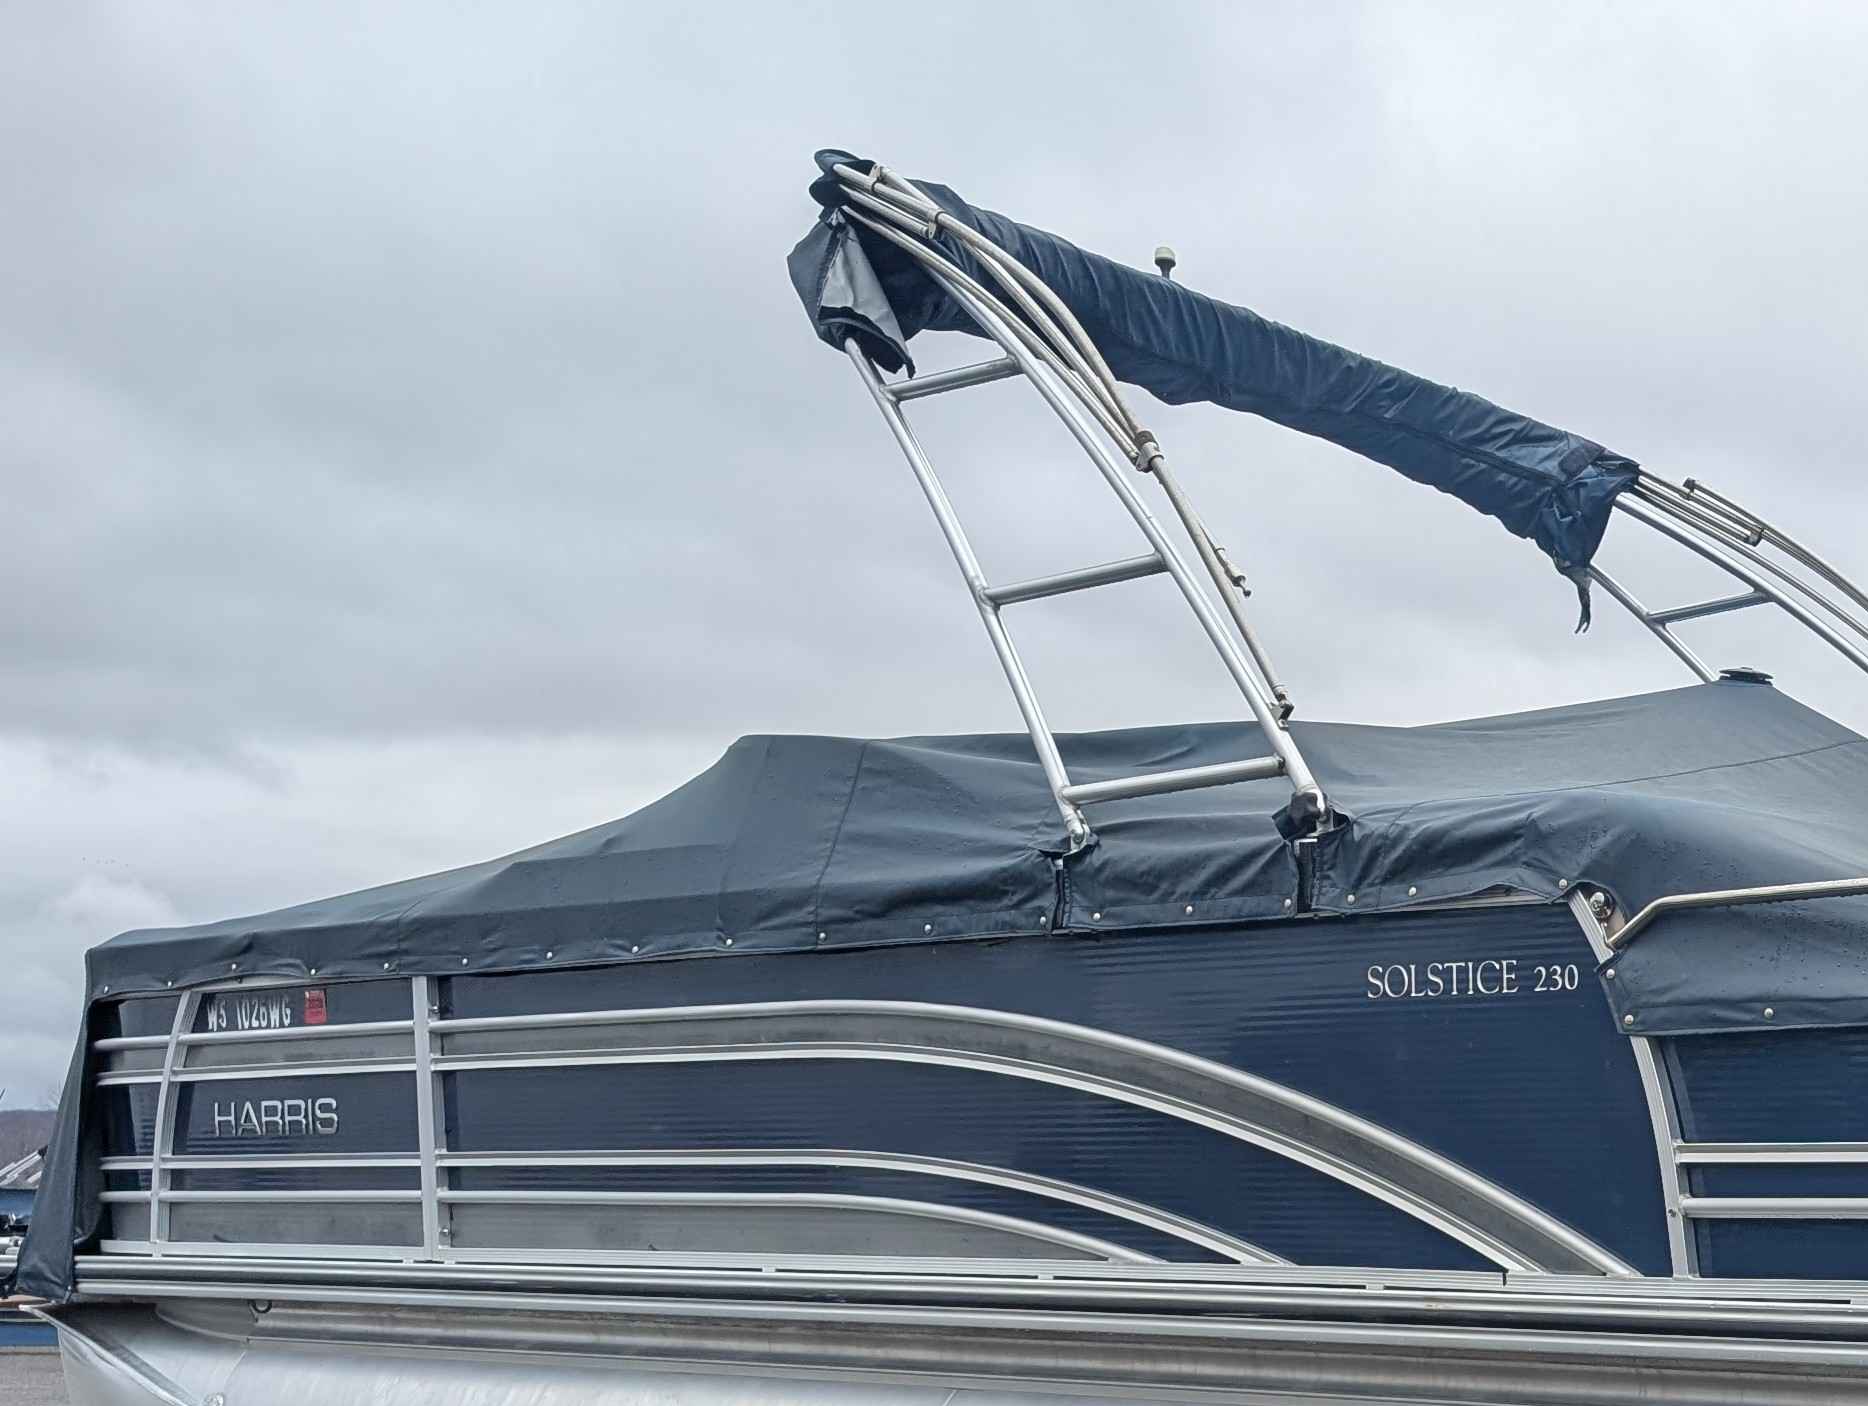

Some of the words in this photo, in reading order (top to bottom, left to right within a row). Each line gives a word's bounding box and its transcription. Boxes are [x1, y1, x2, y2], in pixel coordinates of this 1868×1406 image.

[1367, 959, 1520, 999] SOLSTICE
[1533, 963, 1579, 992] 230
[214, 1097, 338, 1137] HARRIS
